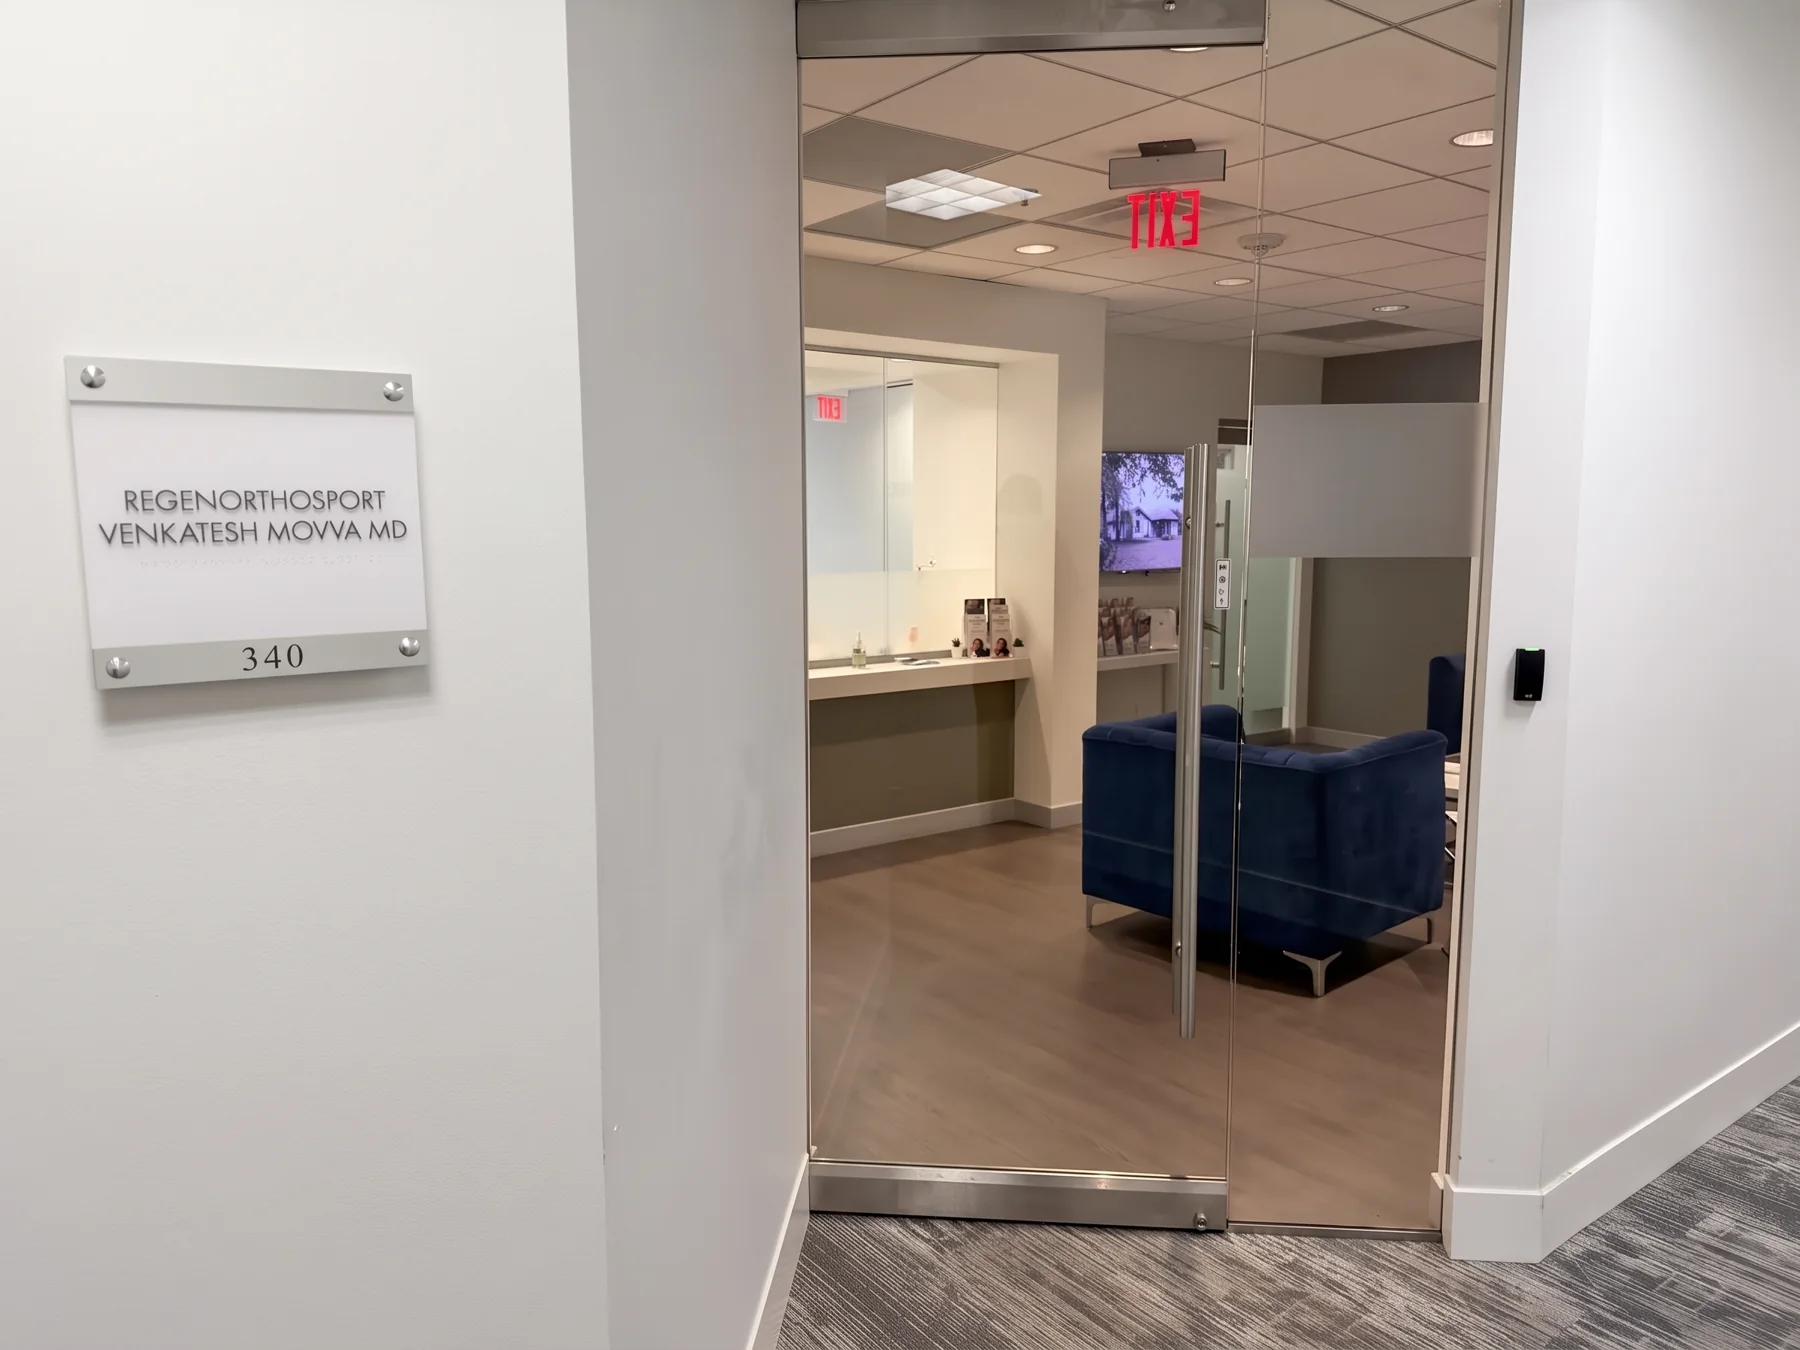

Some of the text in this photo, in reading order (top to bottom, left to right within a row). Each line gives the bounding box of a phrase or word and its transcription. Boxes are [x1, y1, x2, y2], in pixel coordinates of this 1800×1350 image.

[124, 489, 386, 512] REGENORTHOSPORT
[98, 519, 408, 545] VENKATESH MOVVA MD
[241, 643, 304, 672] 340
